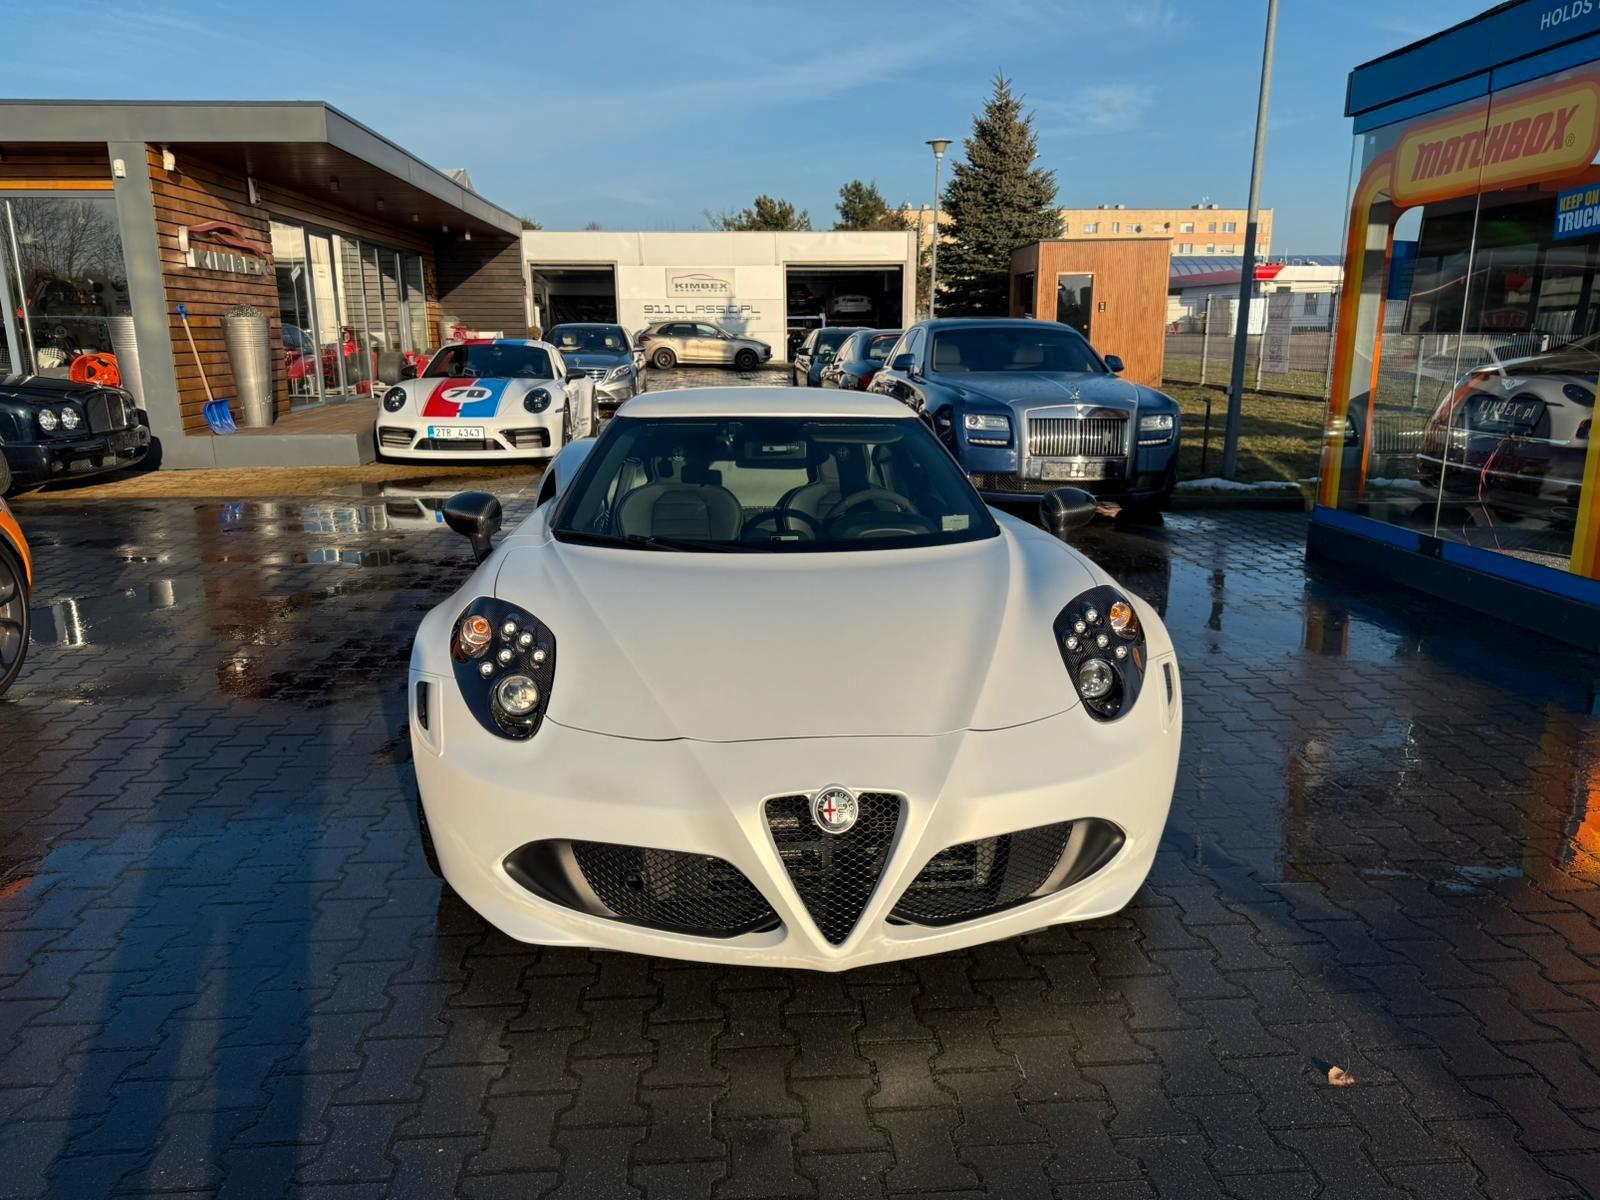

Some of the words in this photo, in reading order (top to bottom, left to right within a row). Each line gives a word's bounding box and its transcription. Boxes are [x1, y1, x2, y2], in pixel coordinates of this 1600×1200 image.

[1540, 0, 1593, 31] HOLDS
[1559, 192, 1584, 212] KEEP
[1585, 188, 1600, 206] ON
[186, 248, 267, 276] KIMBEX
[436, 428, 452, 437] 2TR
[458, 428, 480, 437] 4343
